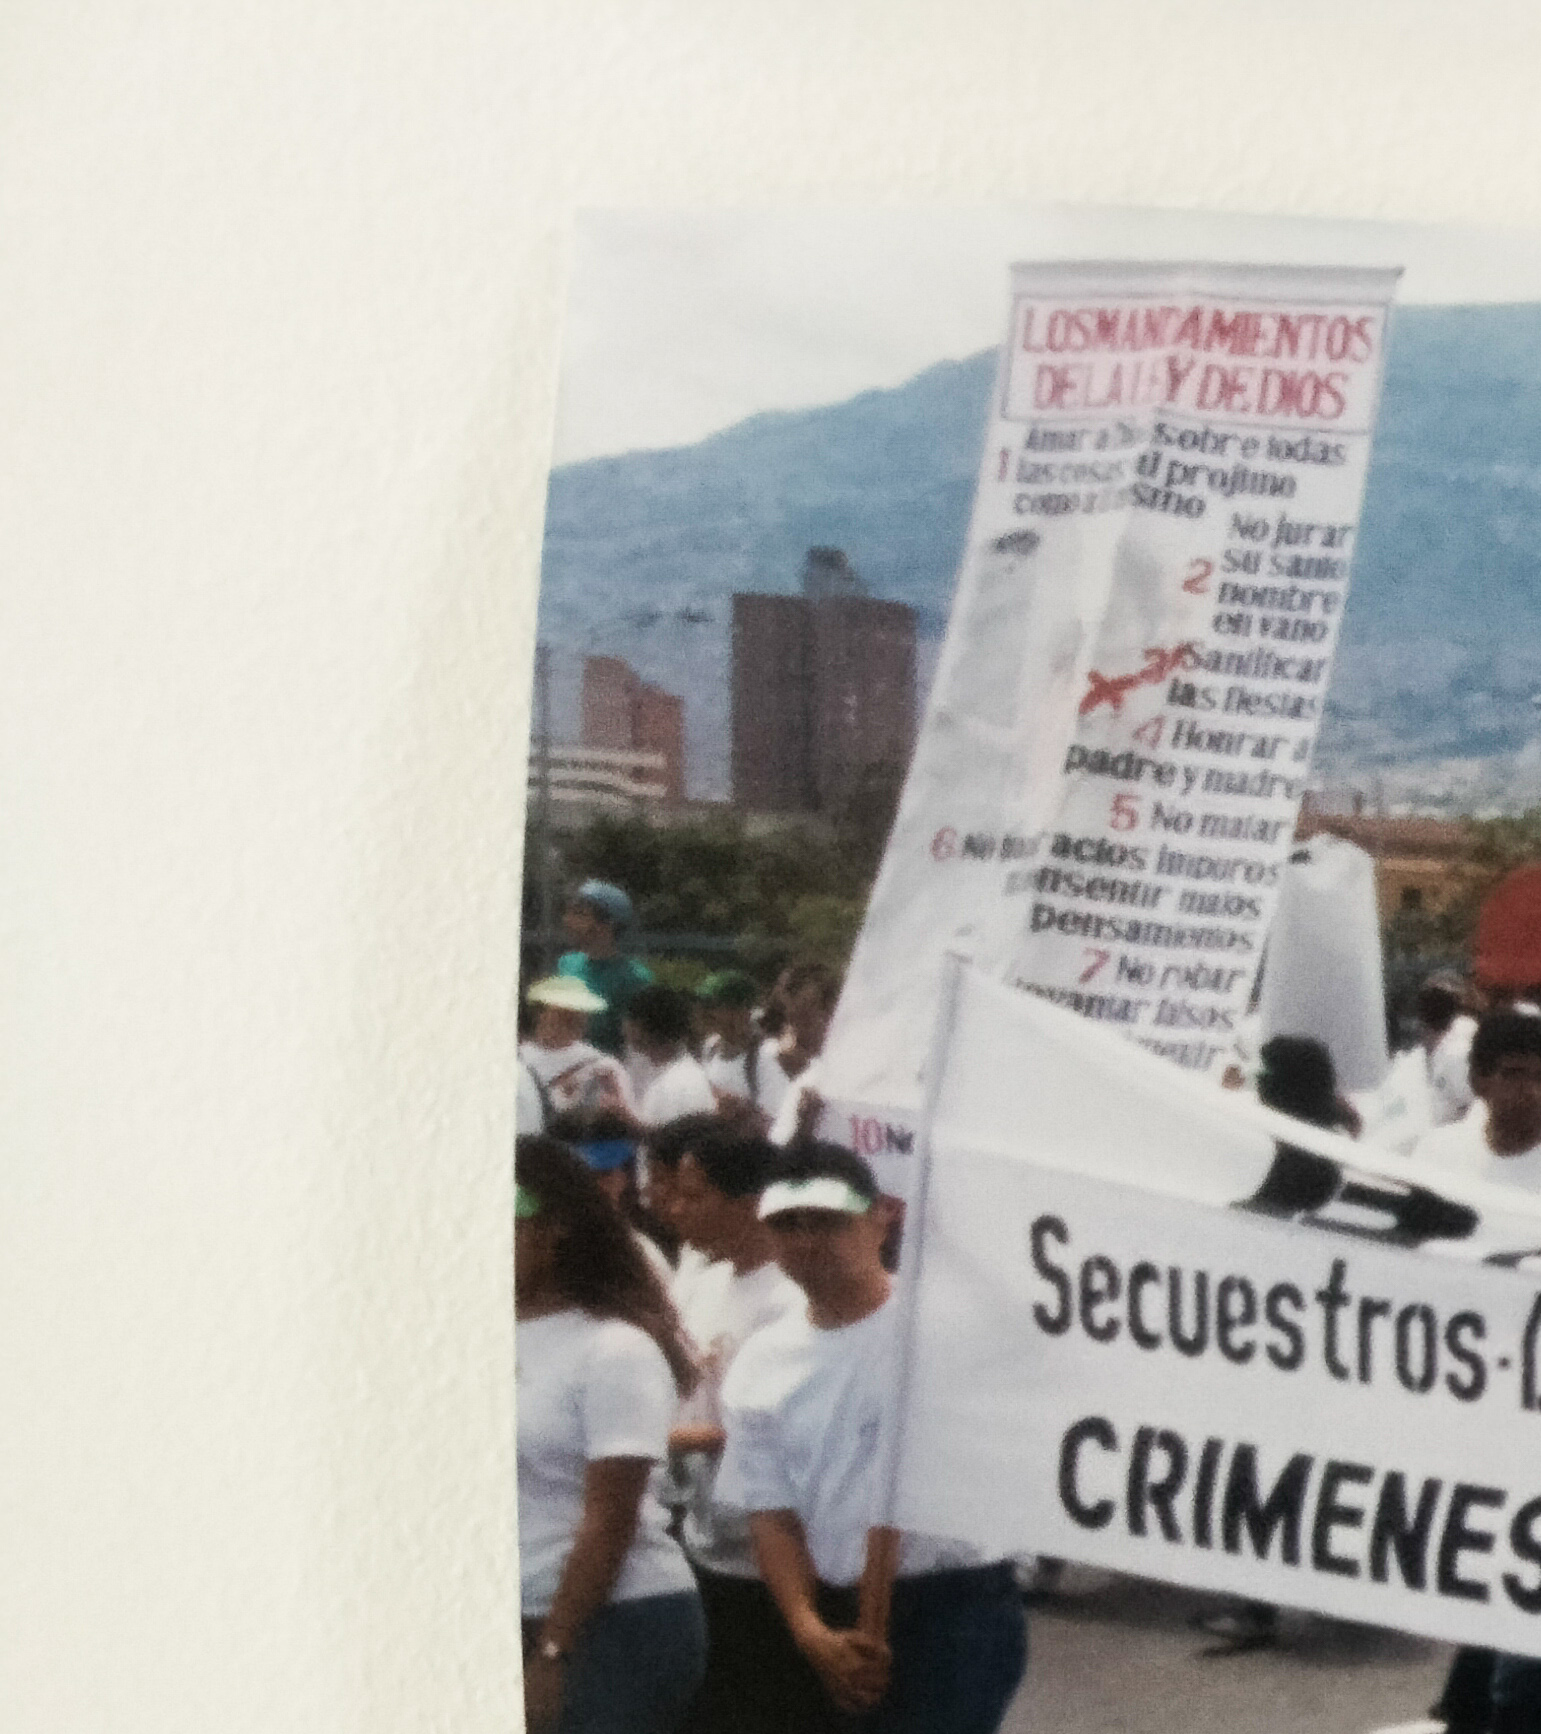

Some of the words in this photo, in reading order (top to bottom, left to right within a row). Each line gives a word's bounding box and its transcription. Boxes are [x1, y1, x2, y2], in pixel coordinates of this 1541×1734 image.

[1255, 366, 1350, 421] DIOS
[1182, 557, 1213, 596] 2
[1132, 714, 1167, 750] 4
[1064, 745, 1178, 787] padre
[1110, 793, 1140, 831] 5
[1151, 801, 1194, 834] No
[1051, 831, 1147, 871] actos
[1079, 946, 1111, 985] 7
[1115, 953, 1156, 987] No
